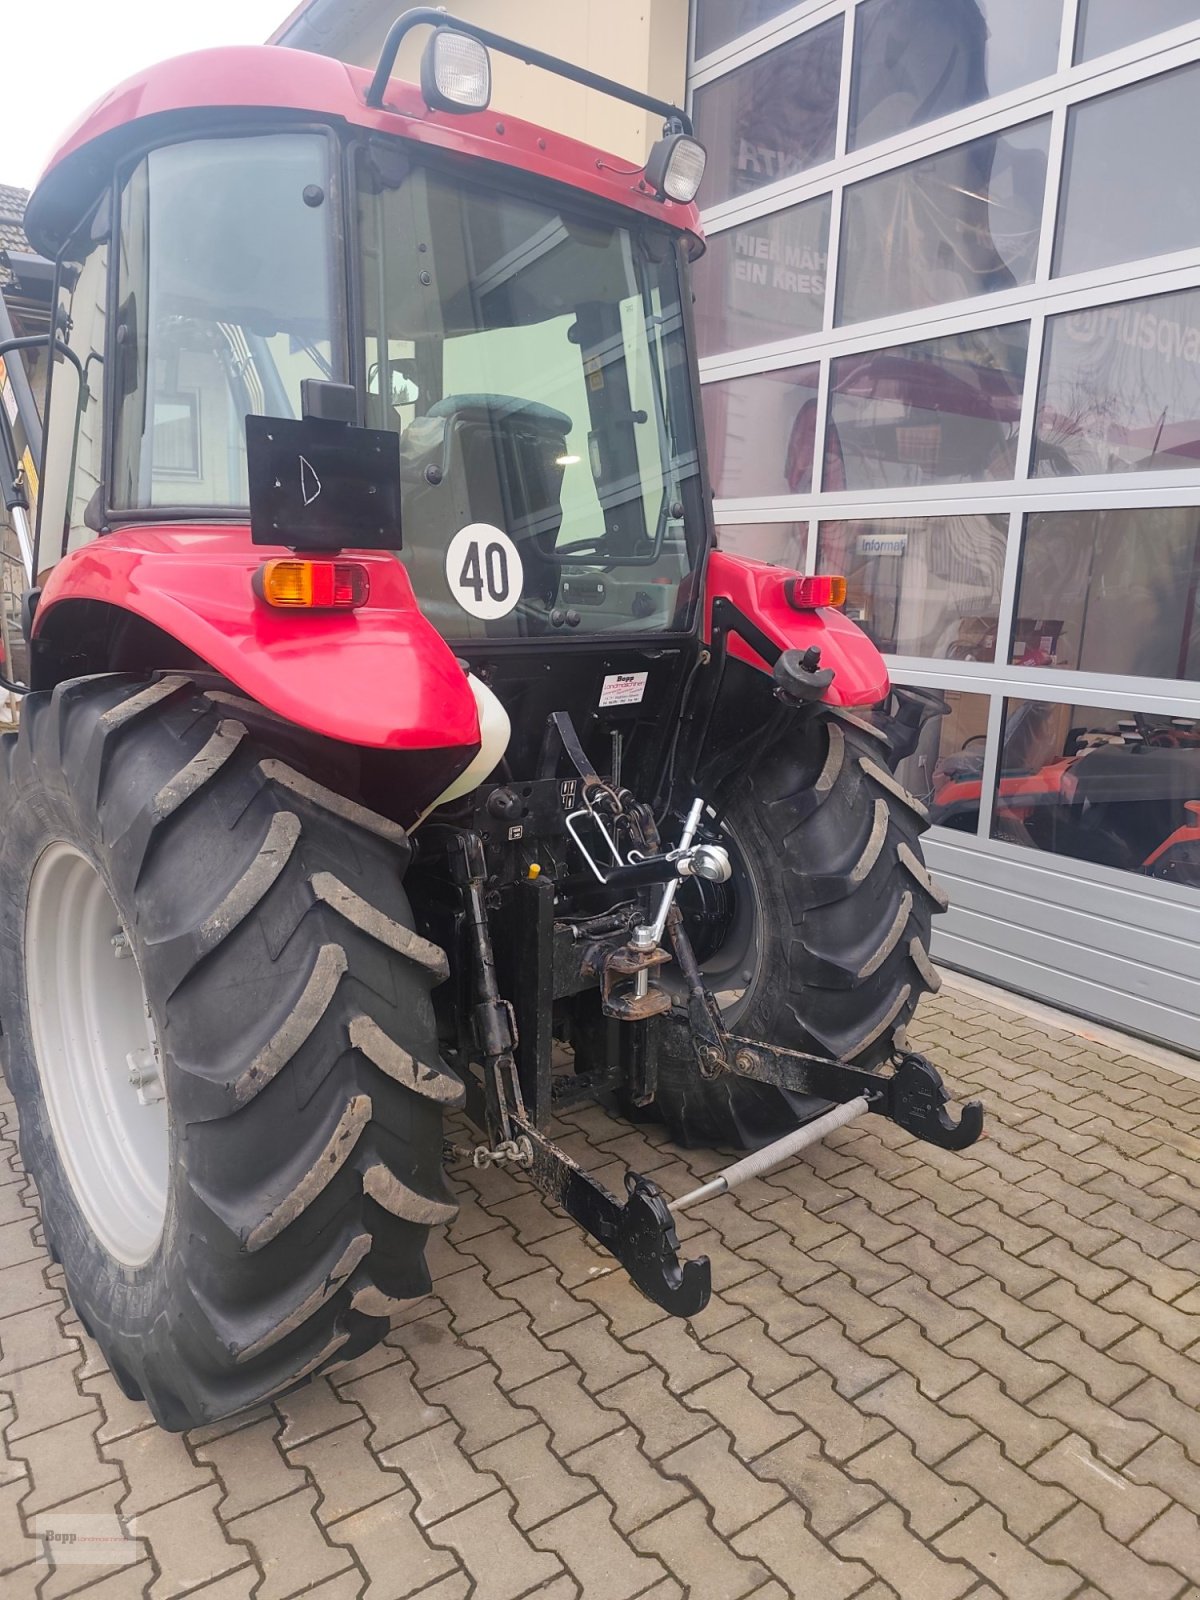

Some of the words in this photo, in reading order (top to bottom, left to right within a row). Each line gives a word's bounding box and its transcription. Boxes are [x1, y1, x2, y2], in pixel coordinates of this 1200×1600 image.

[736, 234, 780, 261] HIER
[735, 259, 767, 285] EIN
[459, 541, 509, 602] 40
